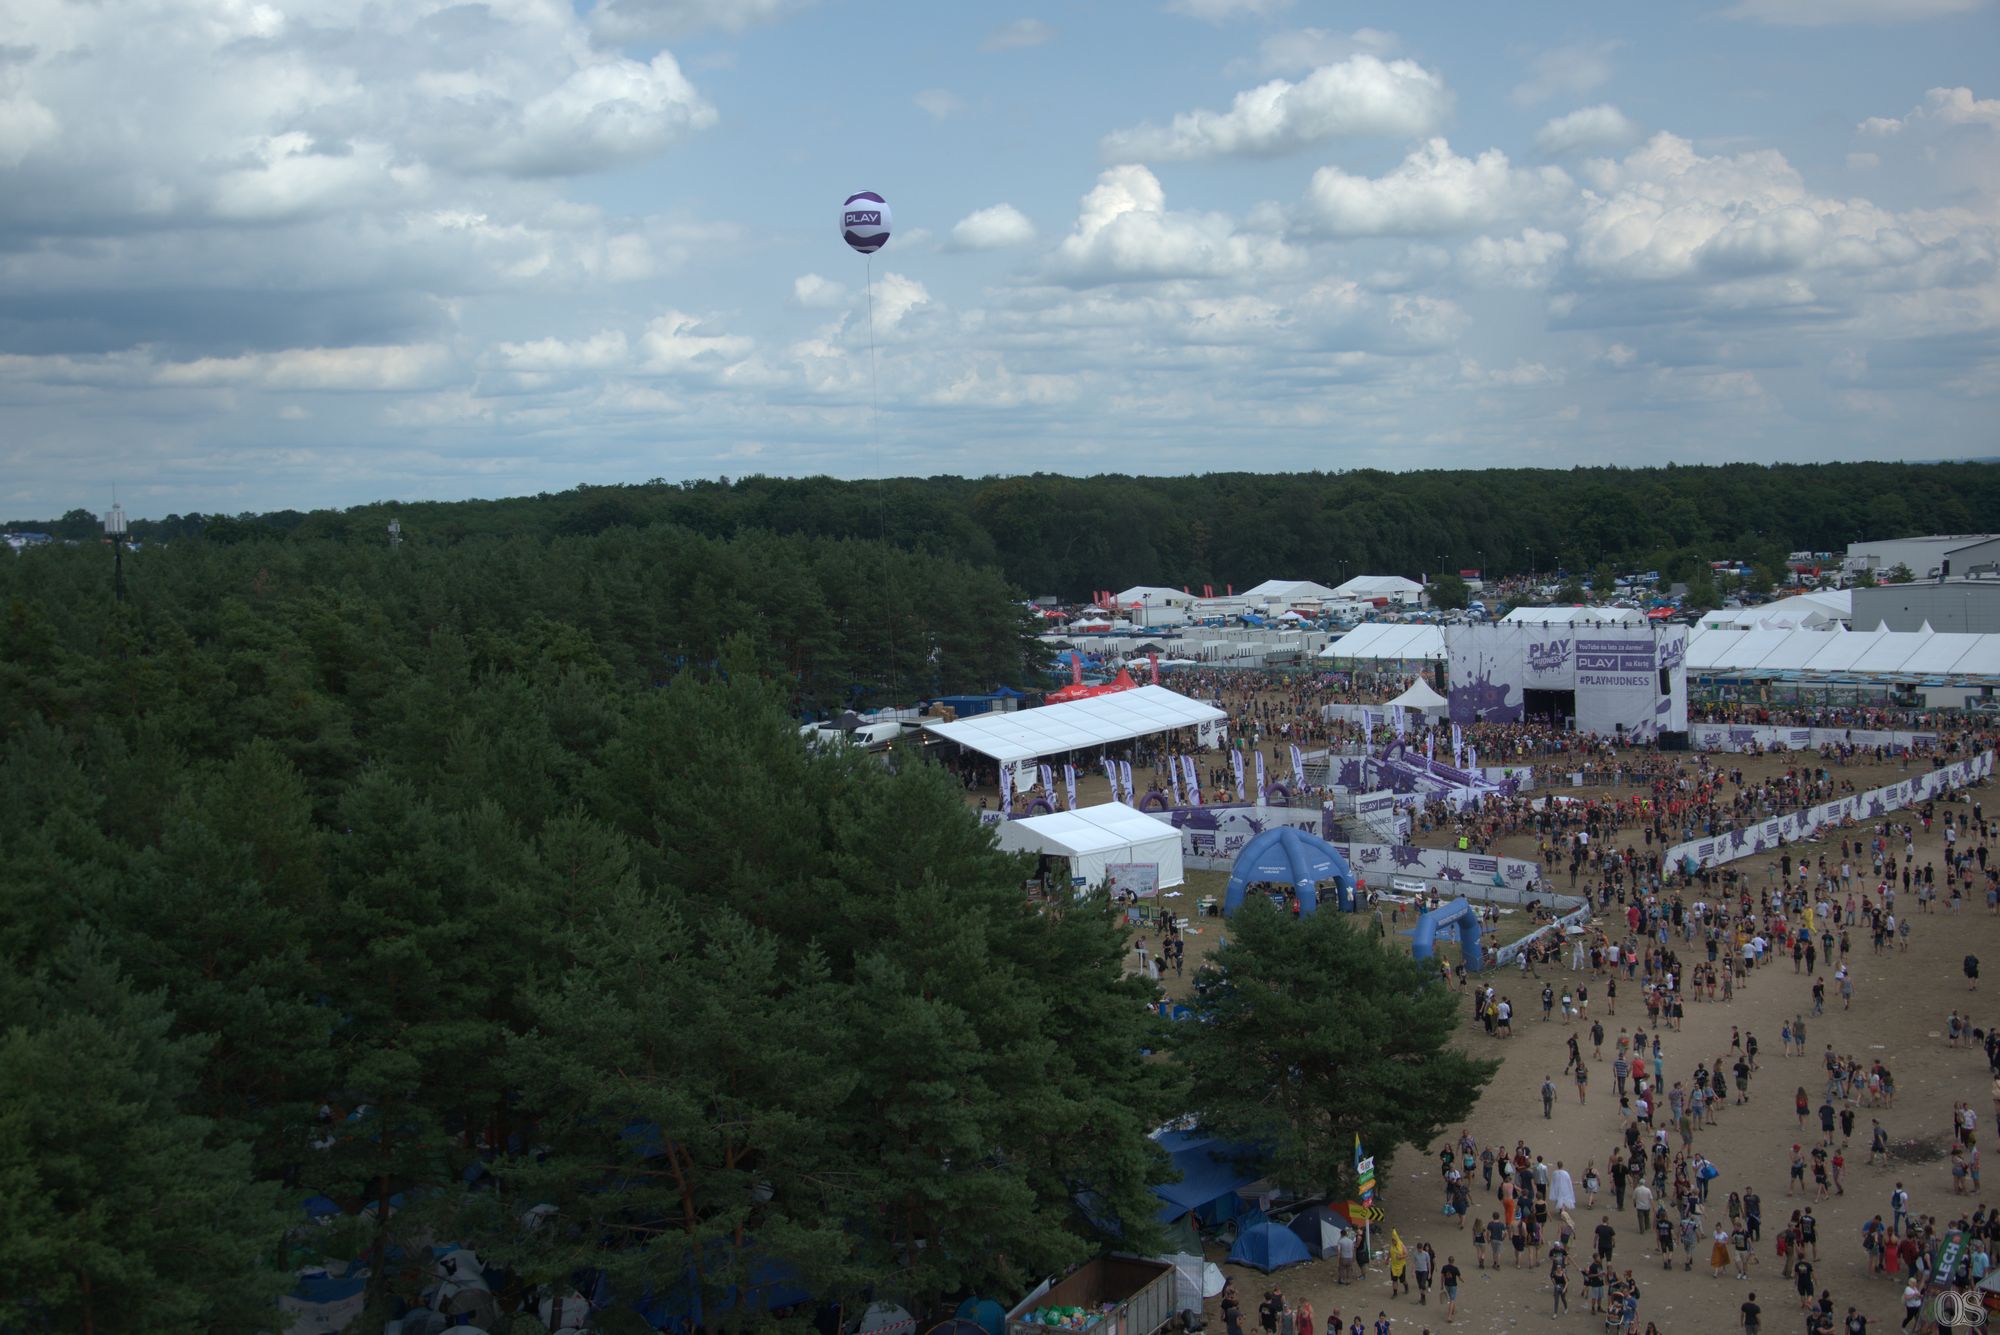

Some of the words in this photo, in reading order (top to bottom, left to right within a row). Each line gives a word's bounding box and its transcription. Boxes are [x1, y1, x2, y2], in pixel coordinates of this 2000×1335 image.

[846, 213, 878, 223] PLAY
[1529, 639, 1571, 658] PLAY
[1659, 637, 1684, 659] PLAY
[1533, 655, 1563, 666] MUDNESS
[1578, 658, 1615, 668] PLAY
[1579, 675, 1649, 686] #PLAYMUDNESS
[1361, 803, 1376, 811] PLAY
[983, 814, 999, 822] PLAY
[1225, 835, 1243, 845] PLAY
[1360, 848, 1380, 856] PLAY
[1508, 865, 1526, 873] PLAY
[1935, 1243, 1960, 1283] LECH
